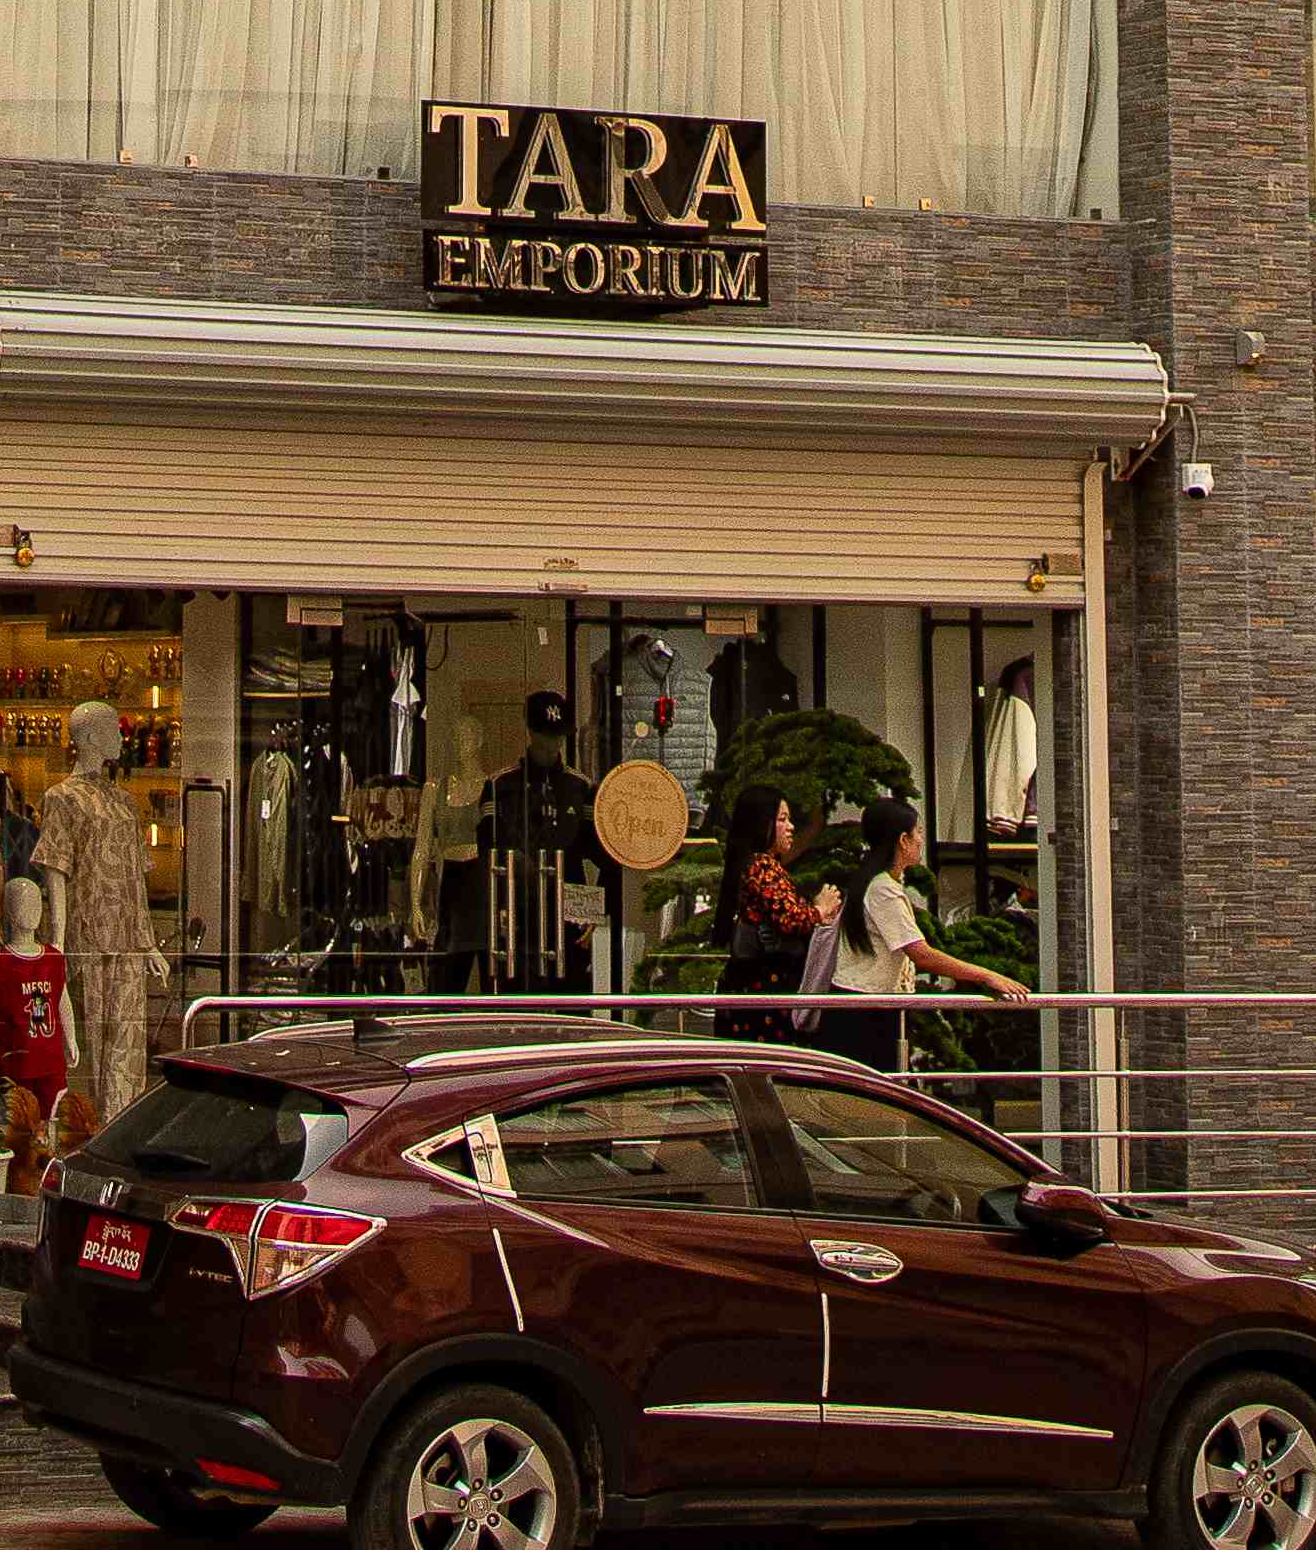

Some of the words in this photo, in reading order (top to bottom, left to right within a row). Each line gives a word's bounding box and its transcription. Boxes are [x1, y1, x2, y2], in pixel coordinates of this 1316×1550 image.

[429, 104, 765, 231] TARA
[433, 235, 762, 301] EMPORIUM
[82, 1240, 141, 1271] BP-1-D4333
